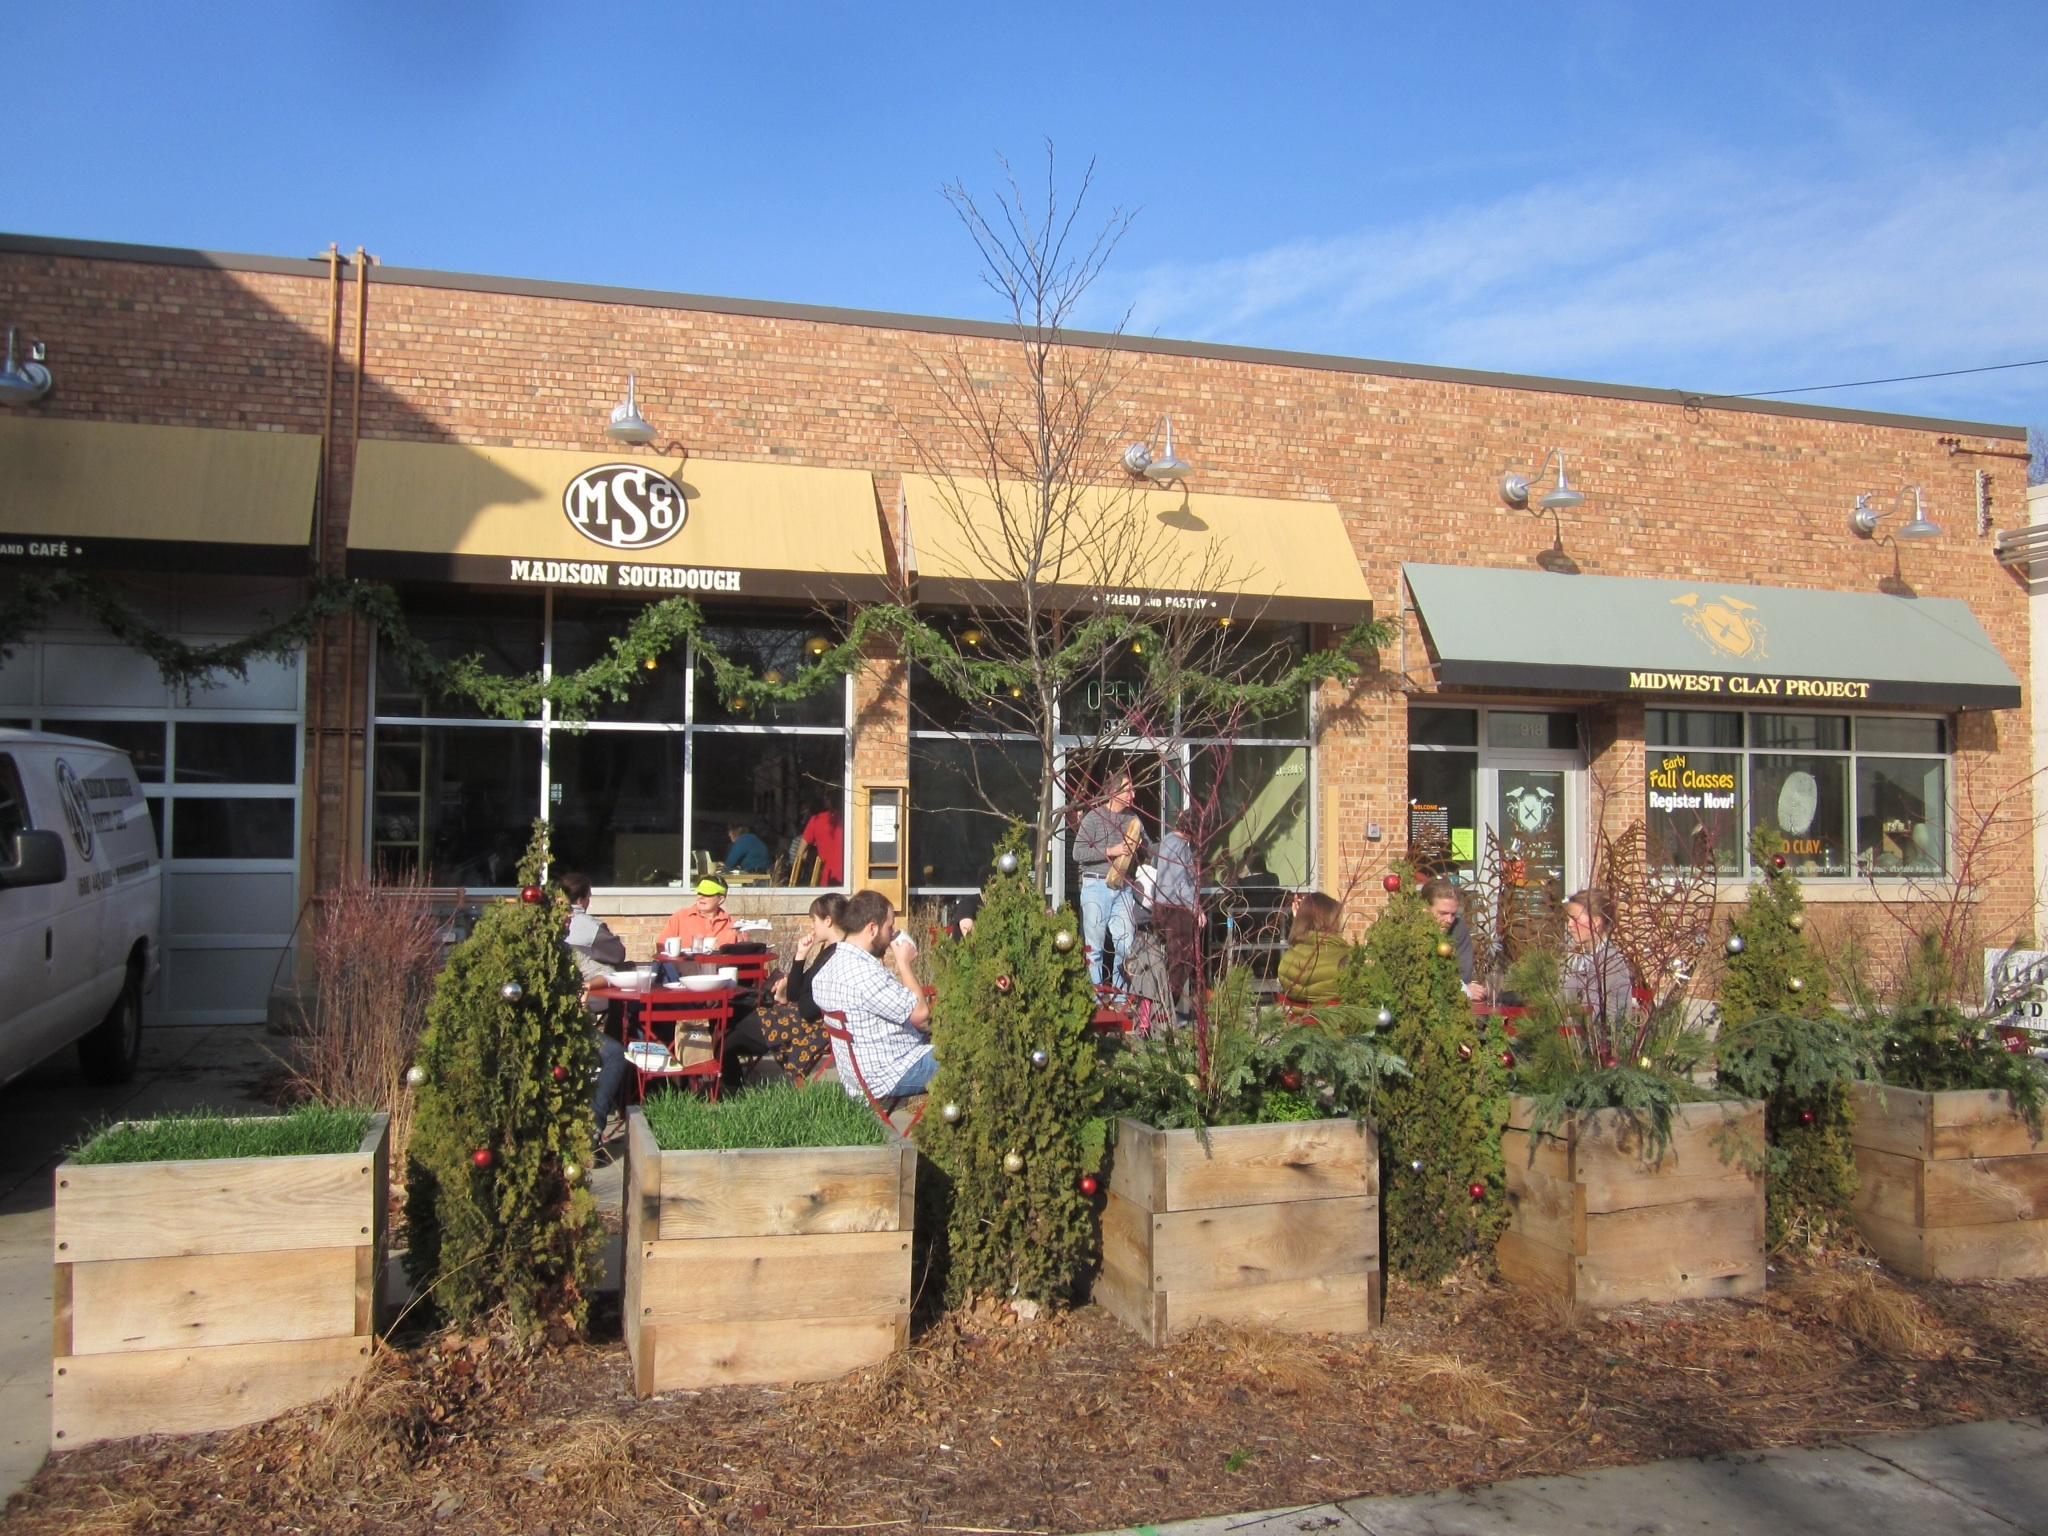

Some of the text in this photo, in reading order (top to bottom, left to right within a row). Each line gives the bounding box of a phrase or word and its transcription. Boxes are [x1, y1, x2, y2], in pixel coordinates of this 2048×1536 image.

[0, 541, 68, 557] AND CAFÉ
[511, 559, 741, 591] MADISON SOURDOUGH
[1629, 672, 1870, 698] MIDWEST CLAY PROJECT
[1663, 754, 1686, 770] Early
[1649, 769, 1734, 789] Fall Classes
[1649, 791, 1735, 813] Register Now!
[1793, 839, 1823, 854] CLAY.
